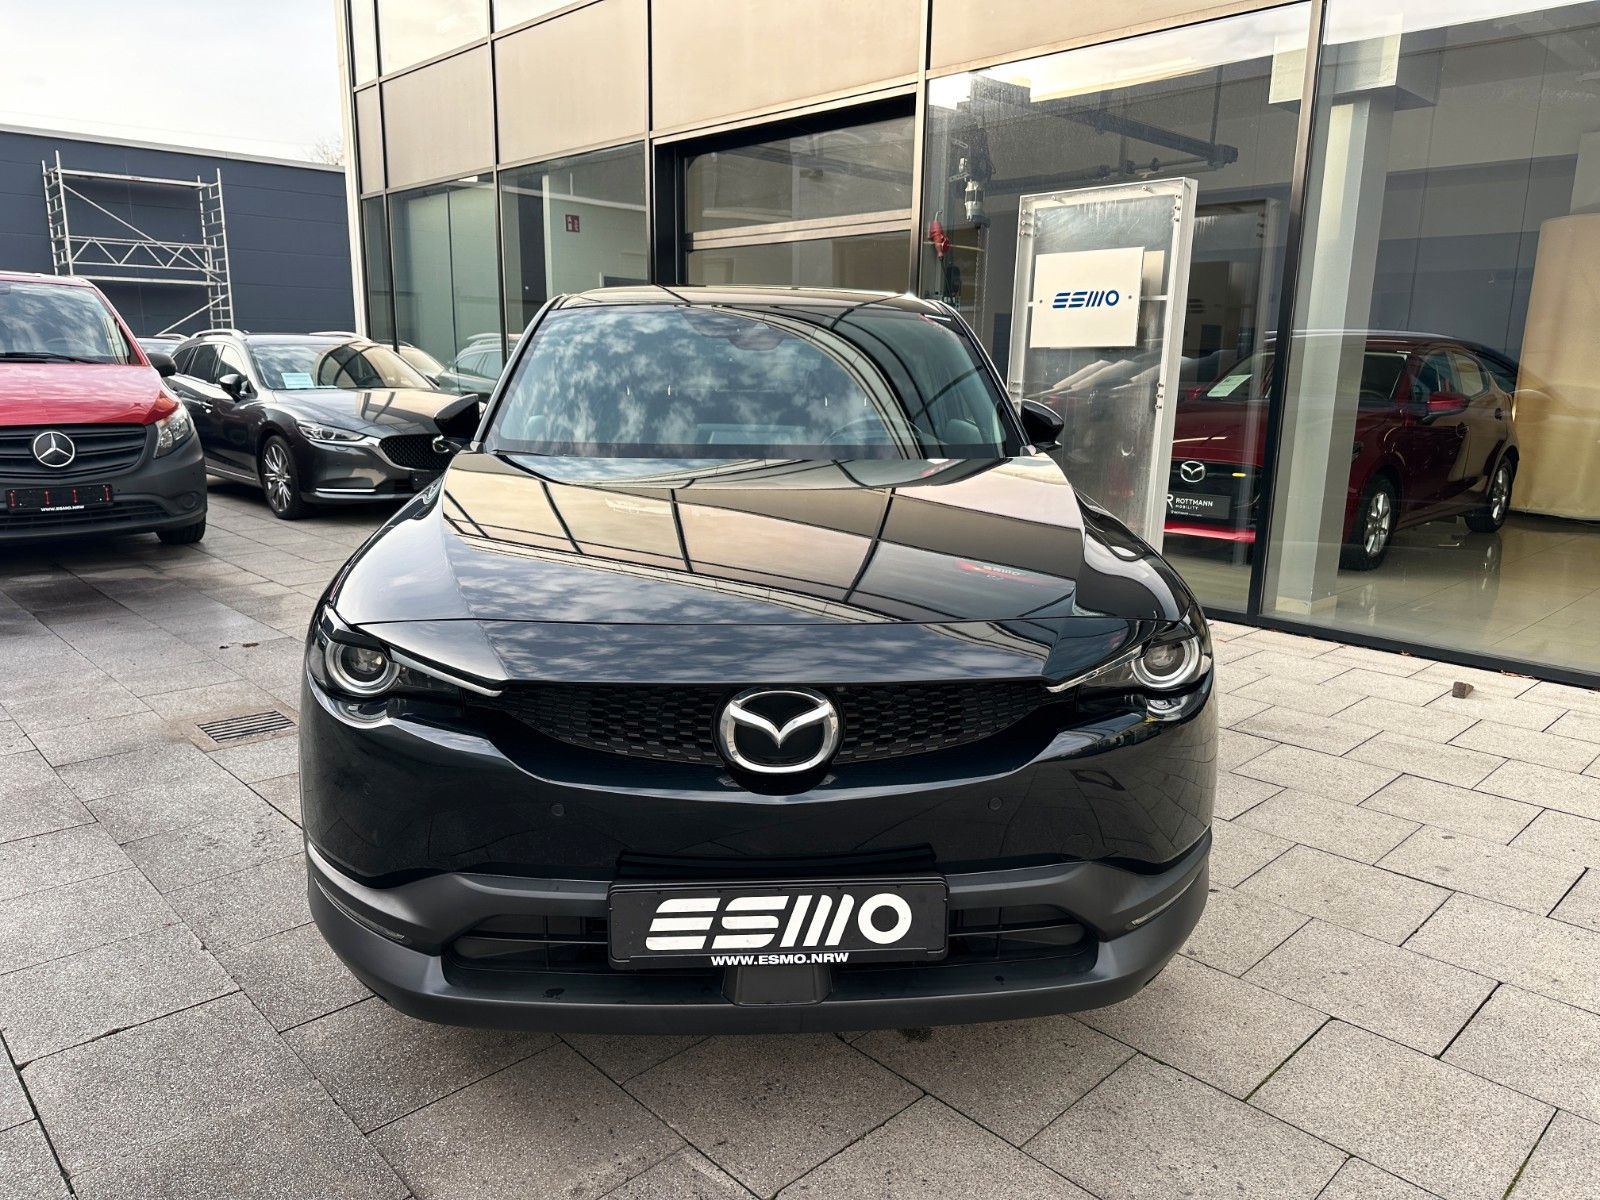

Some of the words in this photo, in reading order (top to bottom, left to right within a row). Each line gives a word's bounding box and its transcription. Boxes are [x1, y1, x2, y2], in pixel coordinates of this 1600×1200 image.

[1052, 290, 1119, 308] ESMO
[1175, 497, 1213, 507] ROTTMANN
[645, 893, 912, 950] ESMO
[711, 952, 849, 966] WWW.ESMO.NRW
